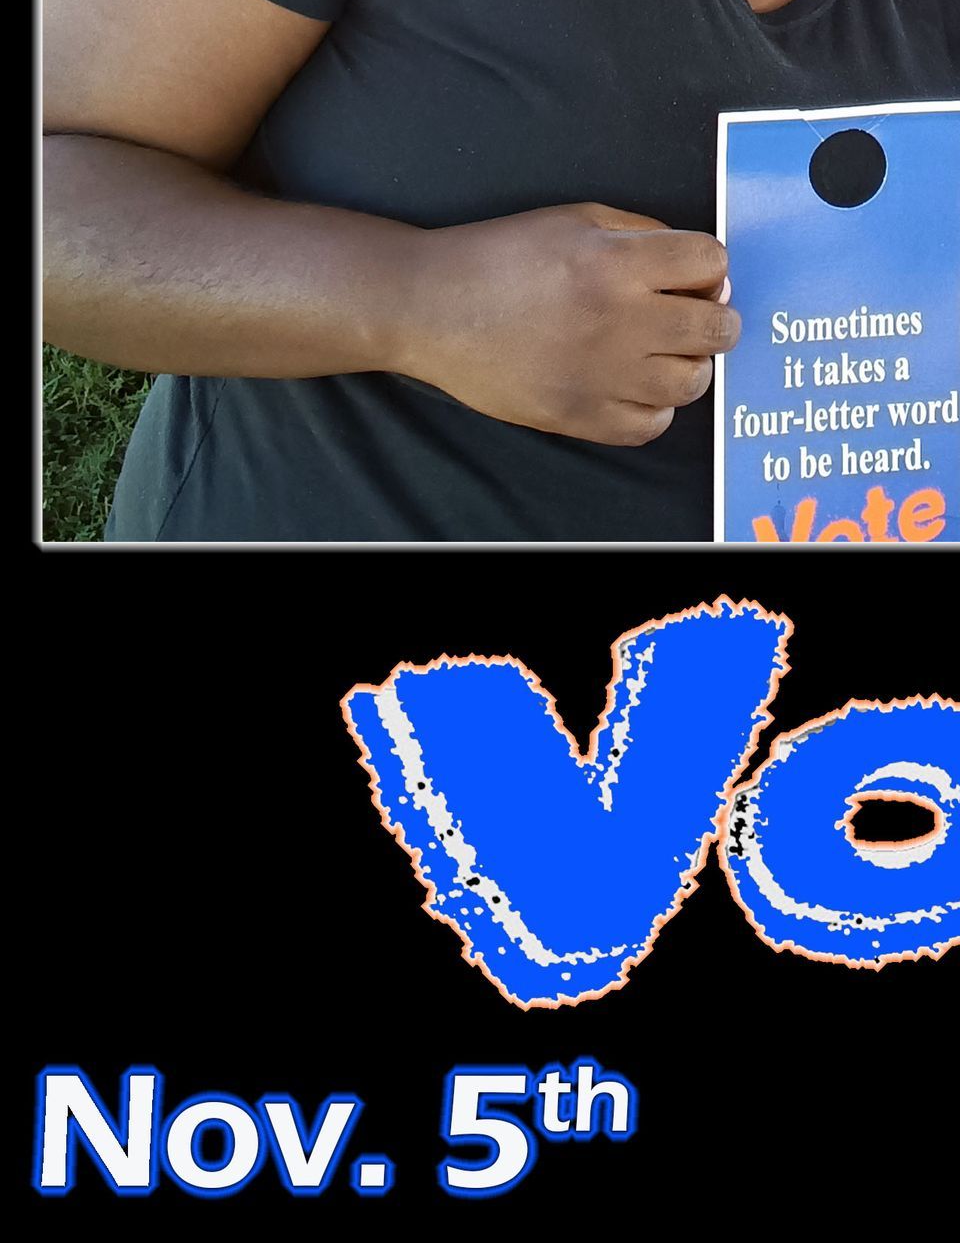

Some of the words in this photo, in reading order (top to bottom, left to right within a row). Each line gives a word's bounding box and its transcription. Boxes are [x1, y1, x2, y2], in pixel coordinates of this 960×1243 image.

[771, 305, 923, 344] Sometimes
[783, 355, 805, 389] it
[812, 352, 886, 387] takes
[894, 356, 911, 382] a
[732, 399, 880, 439] four-letter
[887, 390, 960, 427] word
[762, 450, 791, 482] to
[799, 445, 833, 480] be
[840, 438, 931, 476] heard.
